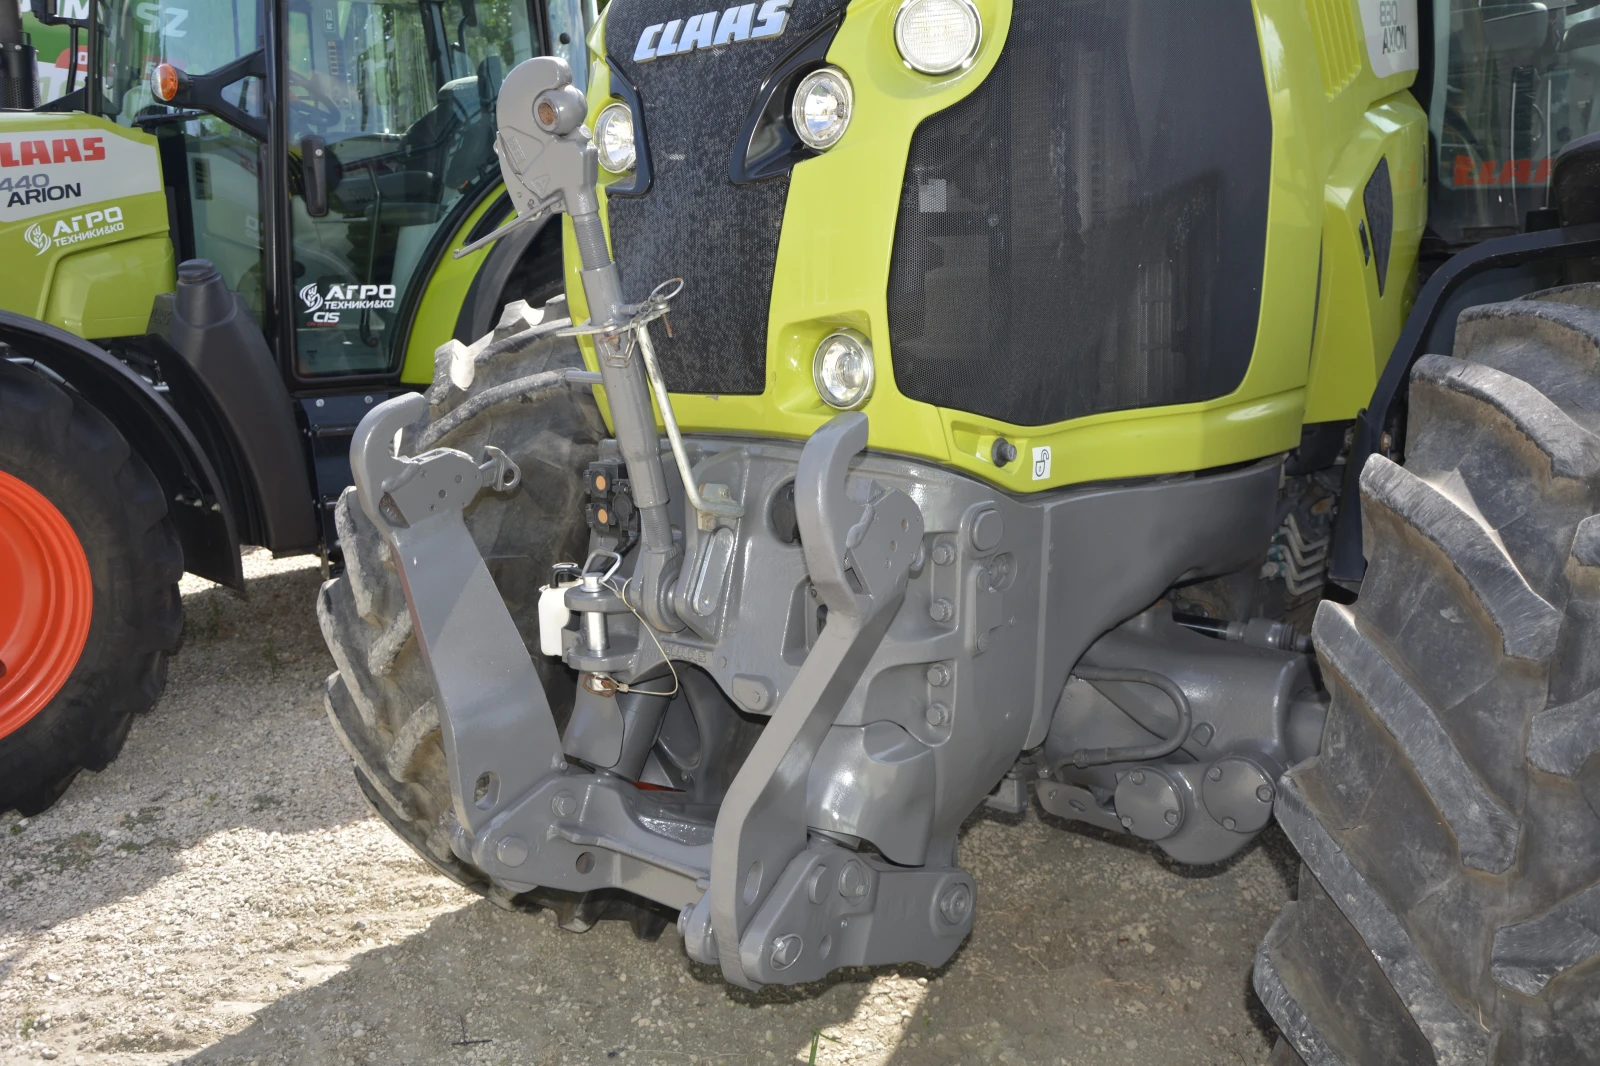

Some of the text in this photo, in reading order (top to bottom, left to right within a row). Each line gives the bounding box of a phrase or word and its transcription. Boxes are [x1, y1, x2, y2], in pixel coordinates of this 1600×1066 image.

[633, 0, 794, 63] CLAAS
[1382, 25, 1407, 54] AXION
[0, 137, 105, 167] LAAS
[0, 173, 50, 193] 440
[7, 183, 82, 208] ARION
[52, 206, 124, 237] АГРО
[53, 222, 125, 248] ТЕХНИКИ&КО
[325, 284, 397, 300] АГРО
[313, 312, 340, 323] CIS
[324, 300, 395, 310] ТЕХНИКИ&КО
